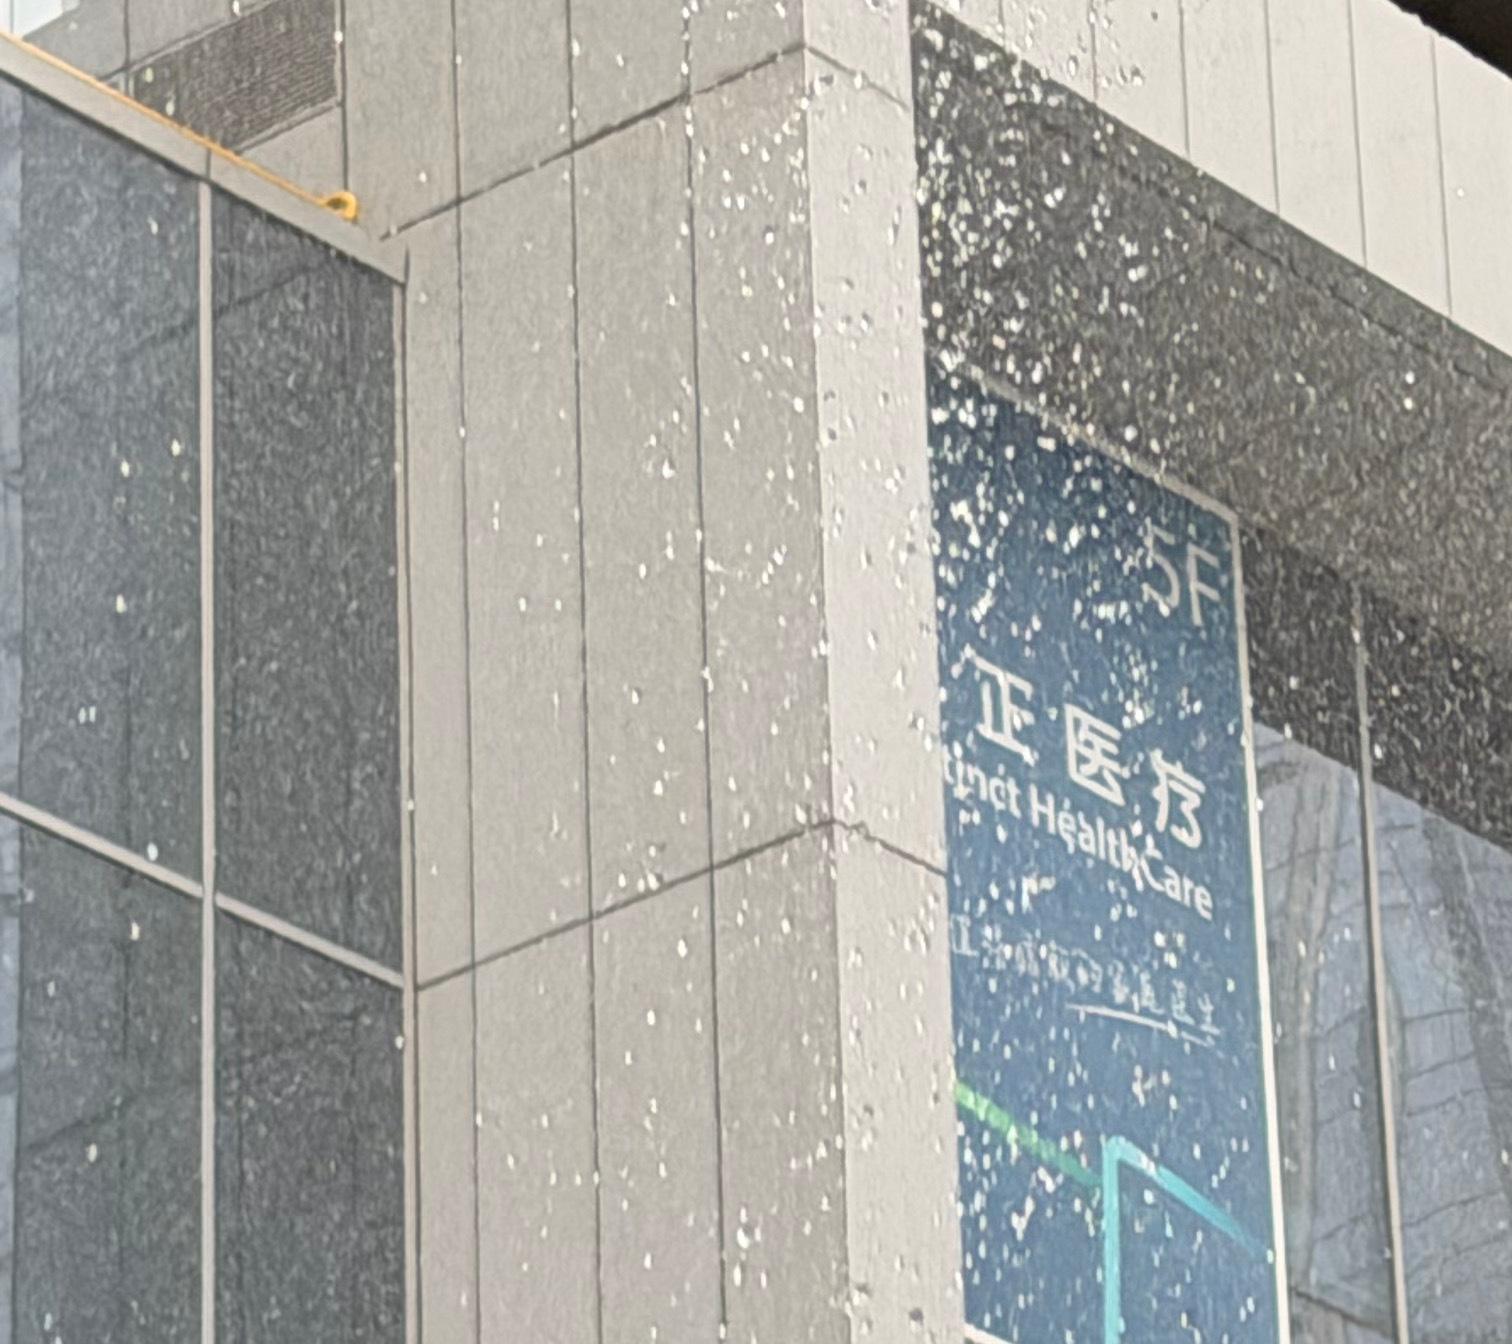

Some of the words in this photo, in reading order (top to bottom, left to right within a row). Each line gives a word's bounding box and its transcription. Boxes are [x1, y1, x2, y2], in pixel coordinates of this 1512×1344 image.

[1141, 524, 1220, 627] 5F
[972, 654, 1206, 849] 正医疗
